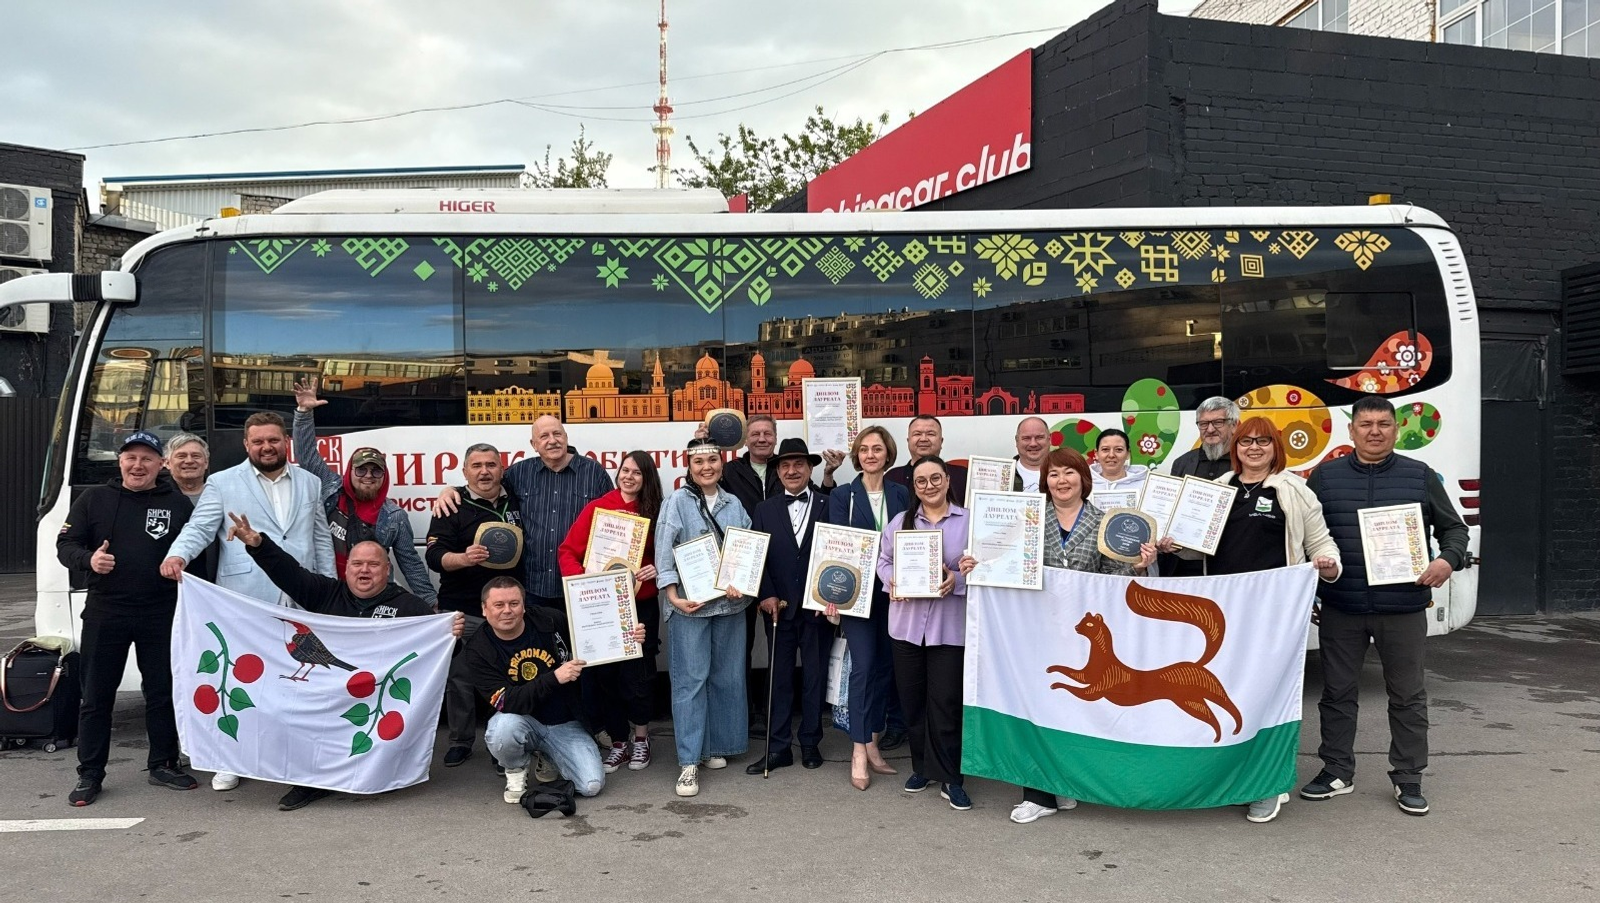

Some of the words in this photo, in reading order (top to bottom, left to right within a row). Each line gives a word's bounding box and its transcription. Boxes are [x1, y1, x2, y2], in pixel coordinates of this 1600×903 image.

[822, 132, 1031, 213] iacar.club
[439, 200, 496, 213] HIGER
[147, 508, 172, 518] БИРСК
